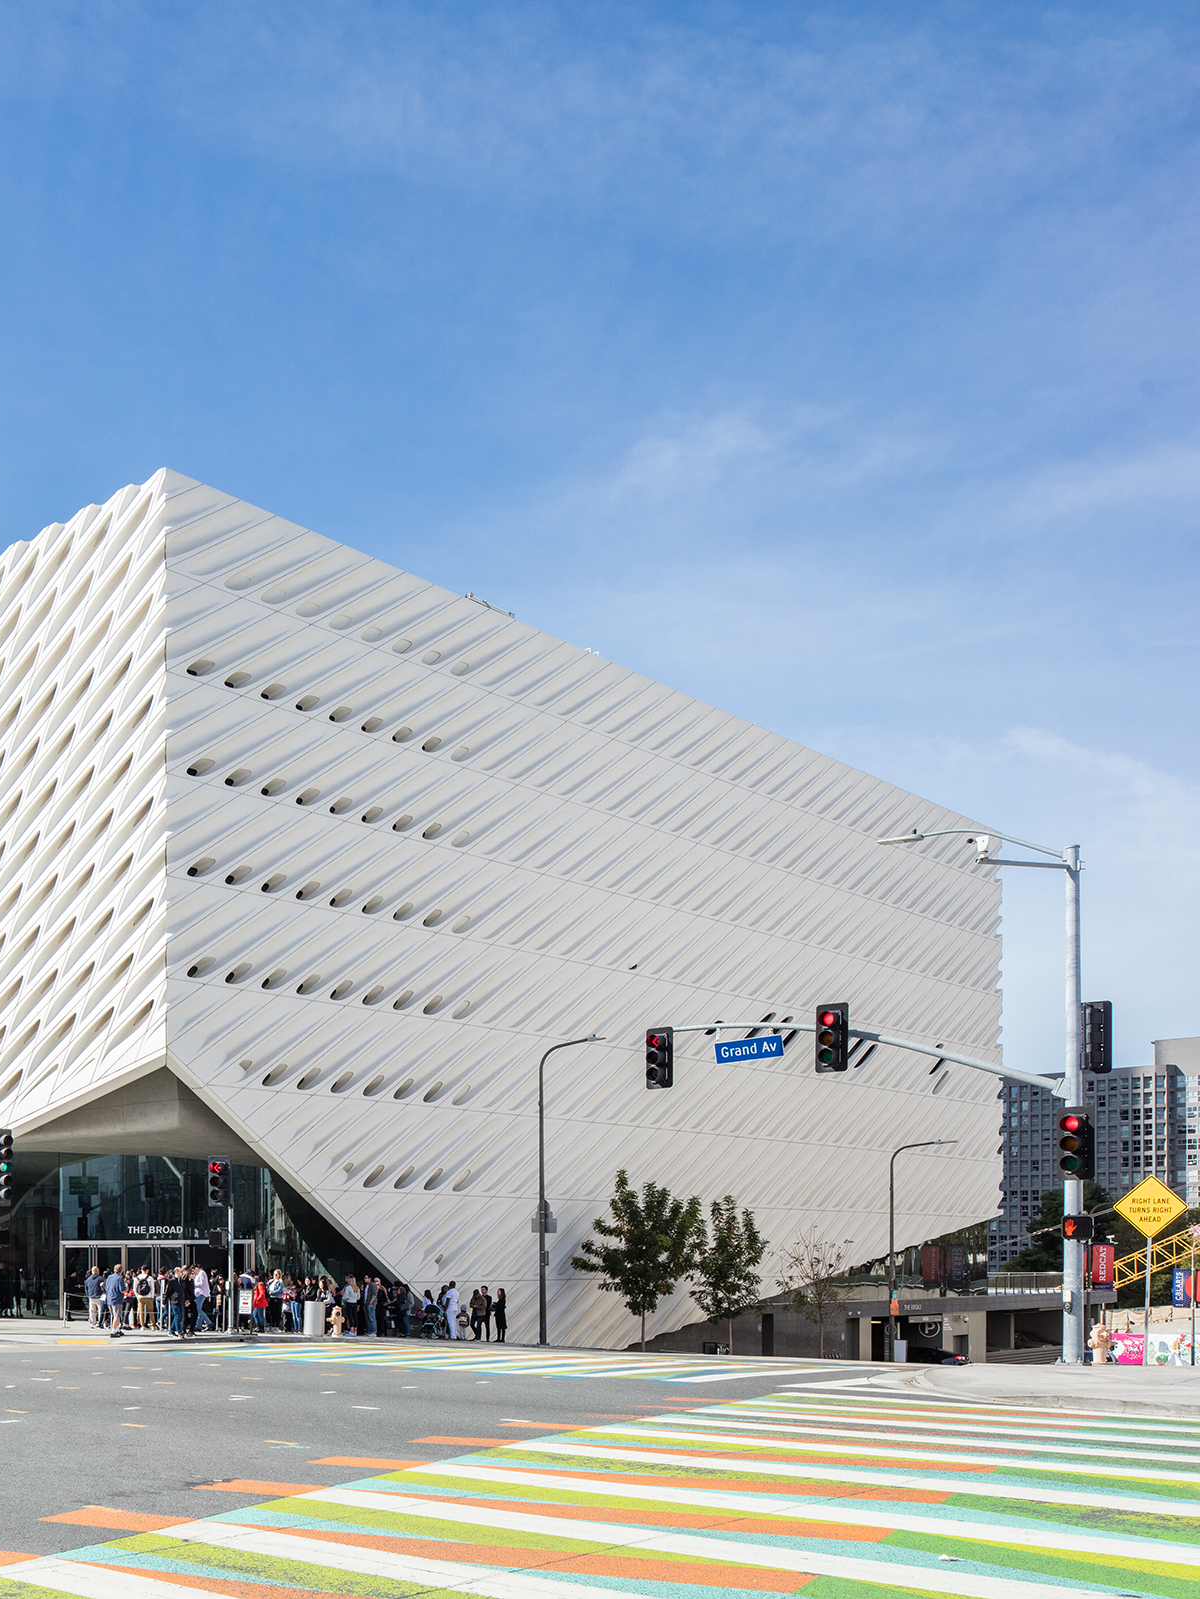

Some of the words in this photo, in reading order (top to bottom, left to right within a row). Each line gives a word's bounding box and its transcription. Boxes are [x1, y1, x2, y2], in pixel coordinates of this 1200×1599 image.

[721, 1042, 757, 1058] Grand
[762, 1041, 777, 1053] Av
[127, 1225, 146, 1234] THE
[149, 1225, 183, 1234] BROAD
